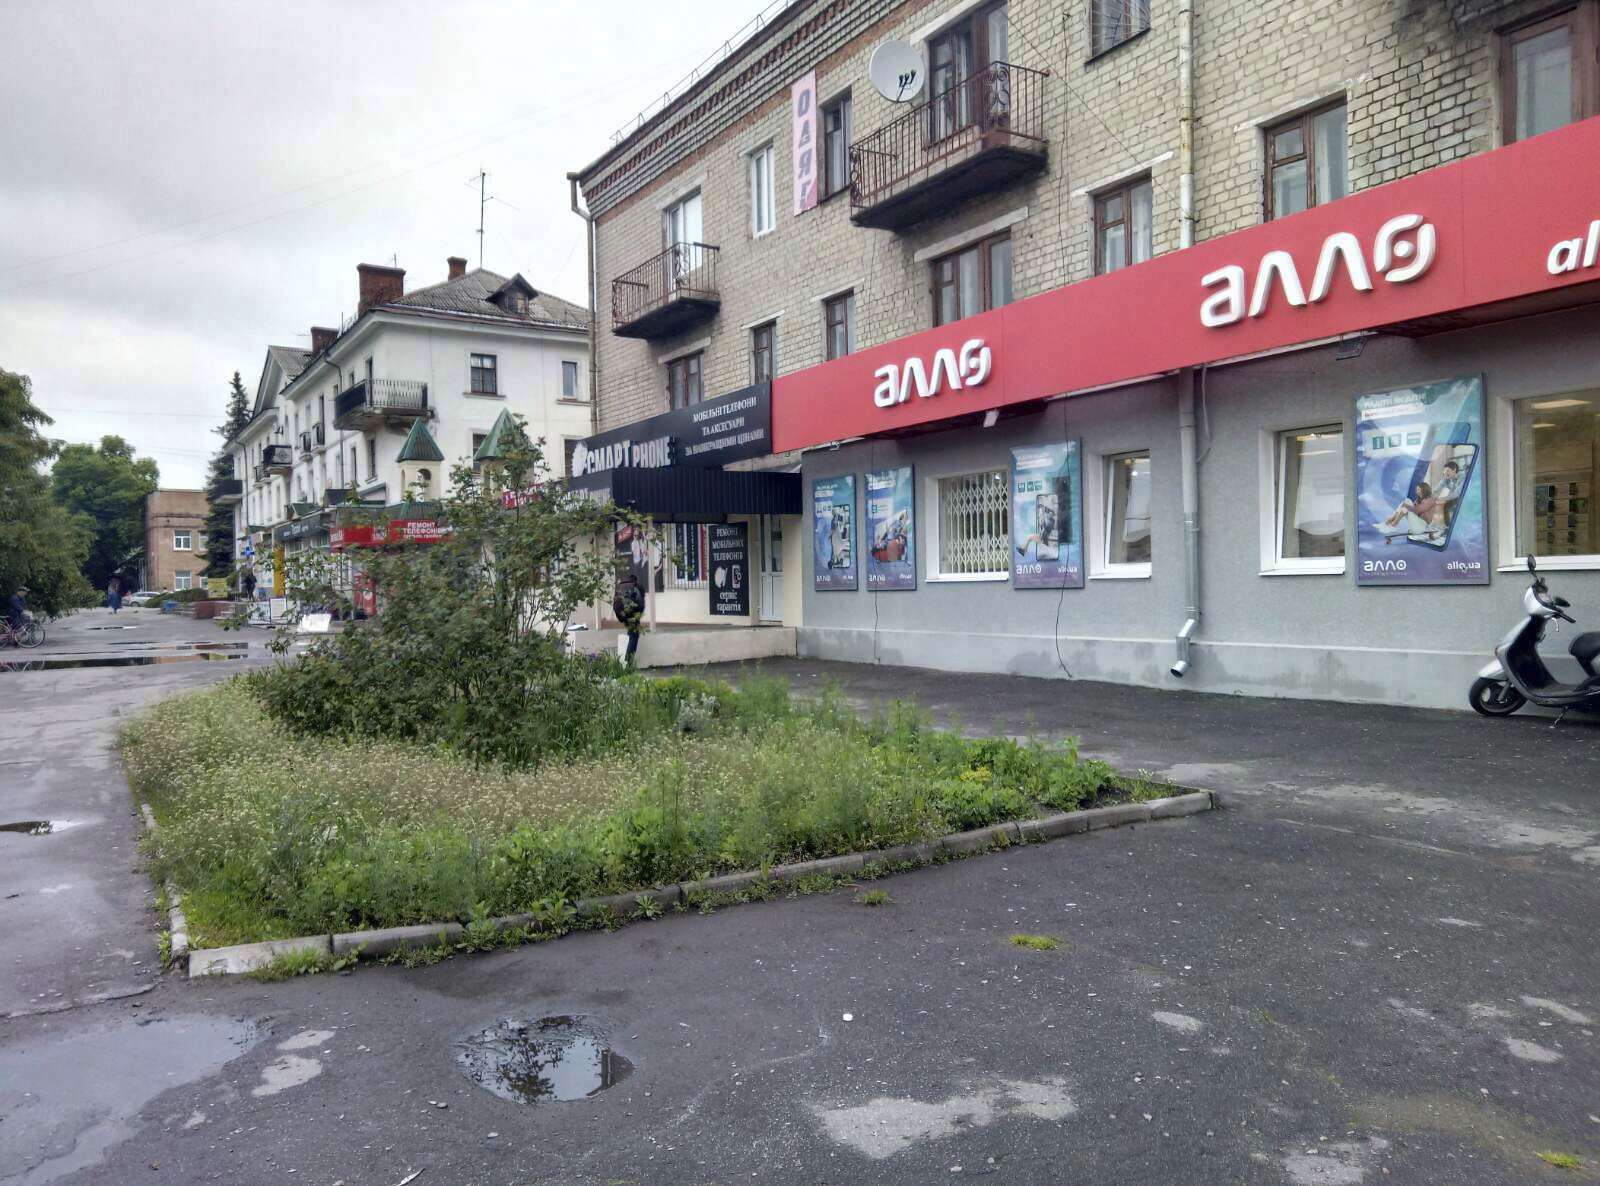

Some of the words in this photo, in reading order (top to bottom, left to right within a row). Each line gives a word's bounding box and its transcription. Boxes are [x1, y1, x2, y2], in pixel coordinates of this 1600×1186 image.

[692, 405, 722, 423] МОБІЛЬНІ
[722, 396, 757, 415] ТЕЛЕФОНИ
[710, 416, 745, 434] АКСЕСУАРИ
